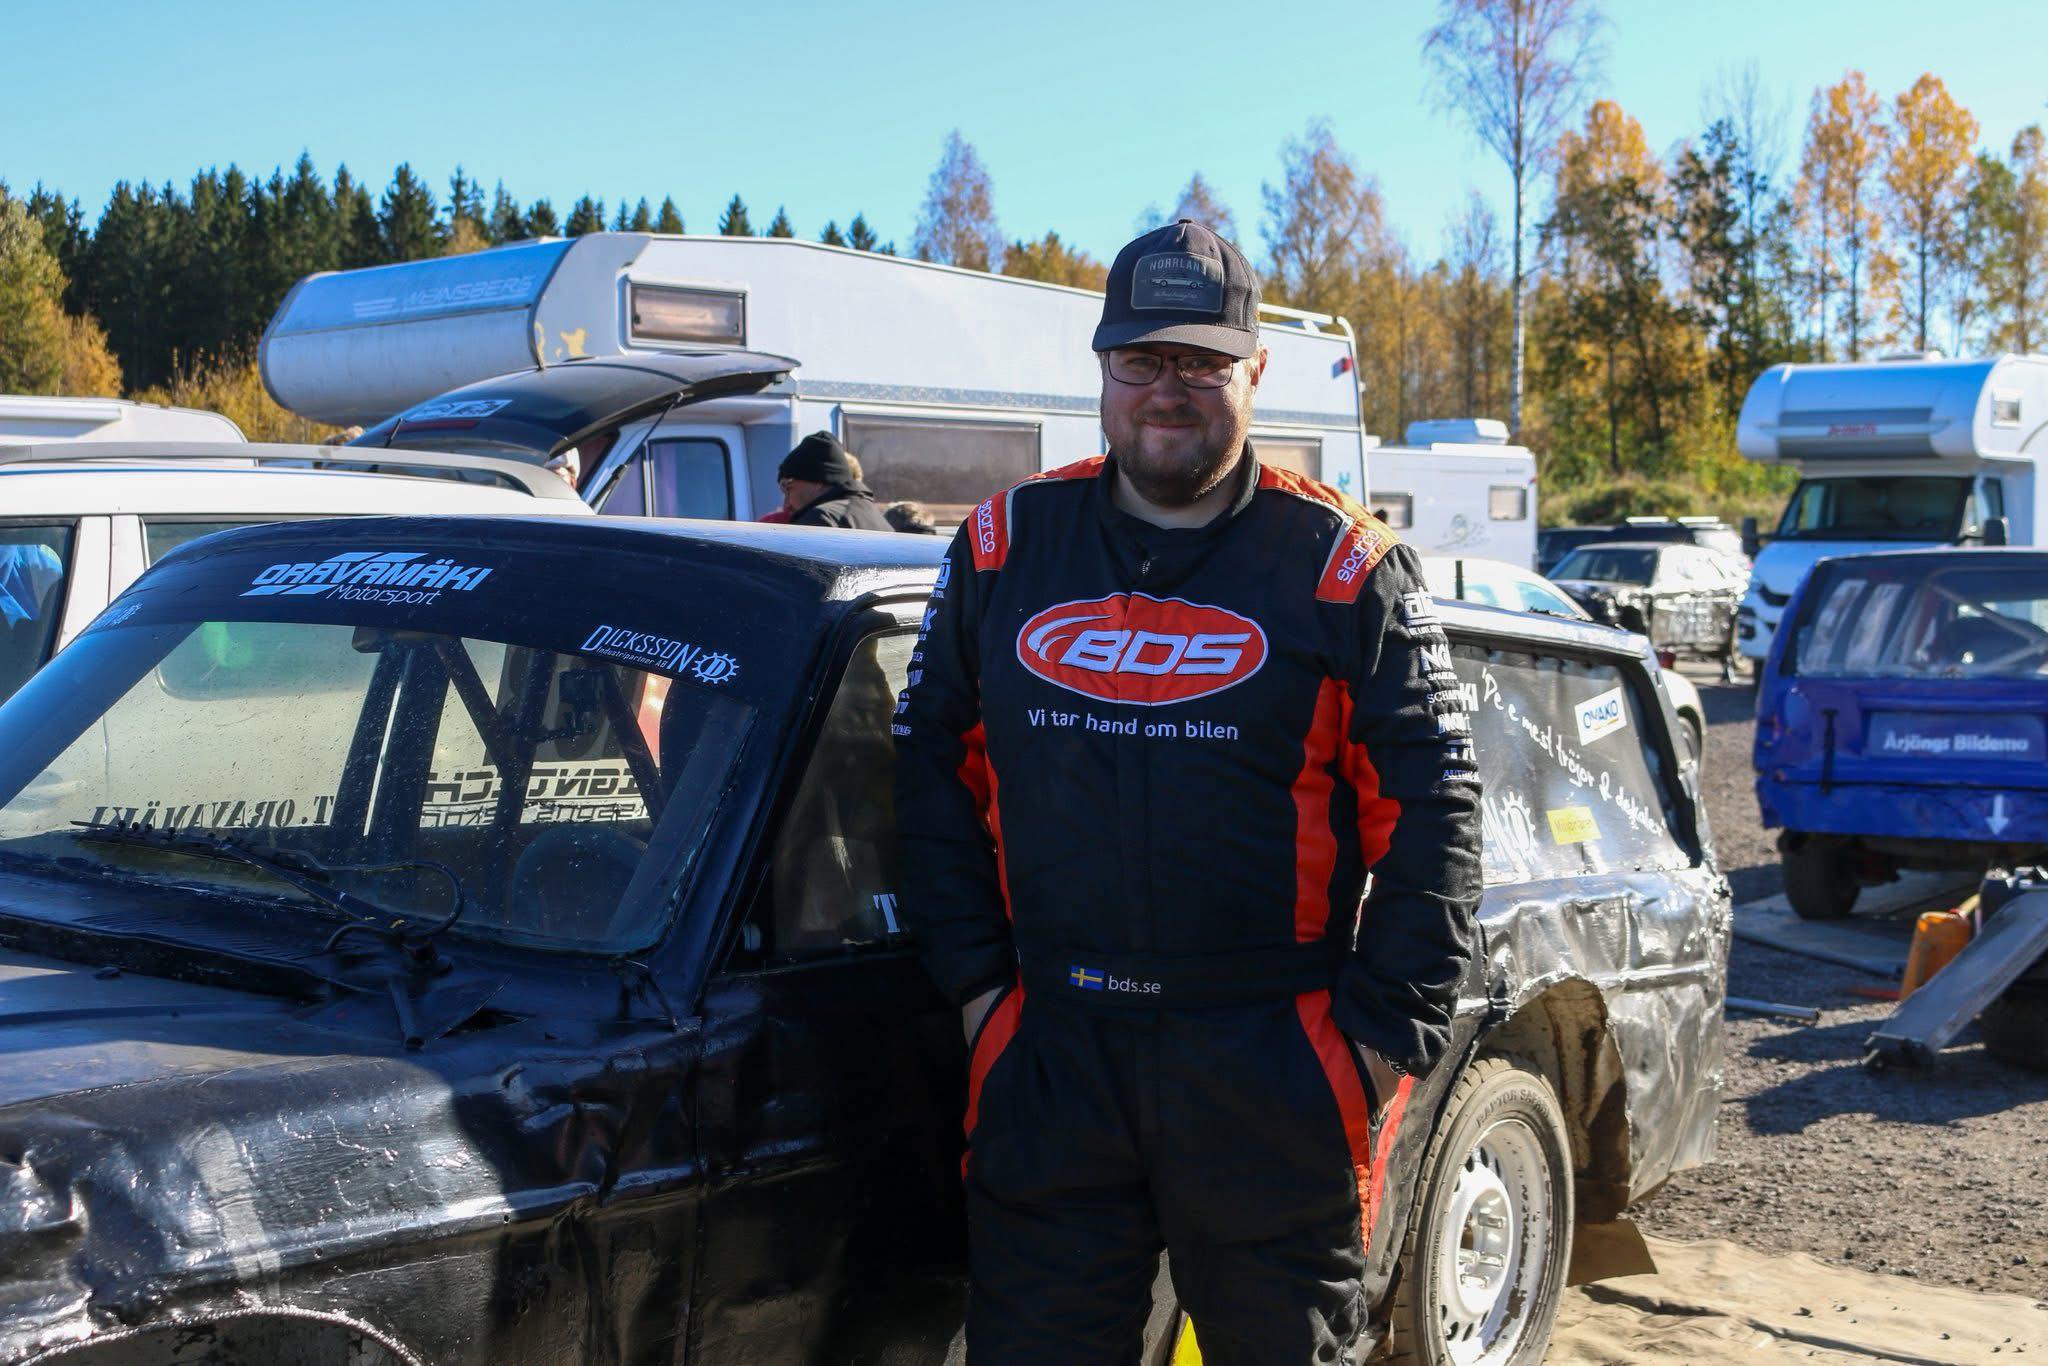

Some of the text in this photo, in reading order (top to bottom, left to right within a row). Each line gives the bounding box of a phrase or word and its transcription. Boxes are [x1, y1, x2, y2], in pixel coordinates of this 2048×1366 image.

[977, 498, 996, 554] sparco
[1337, 529, 1382, 585] sparco
[251, 558, 494, 592] ORAVAMÄKI
[326, 584, 442, 607] Motorsport
[580, 625, 702, 673] DICKSSON
[1058, 629, 1252, 676] BDS
[1027, 708, 1239, 740] Vi tar hand om bilen
[1953, 733, 2030, 753] Bildemo
[1108, 975, 1161, 994] bds.se
